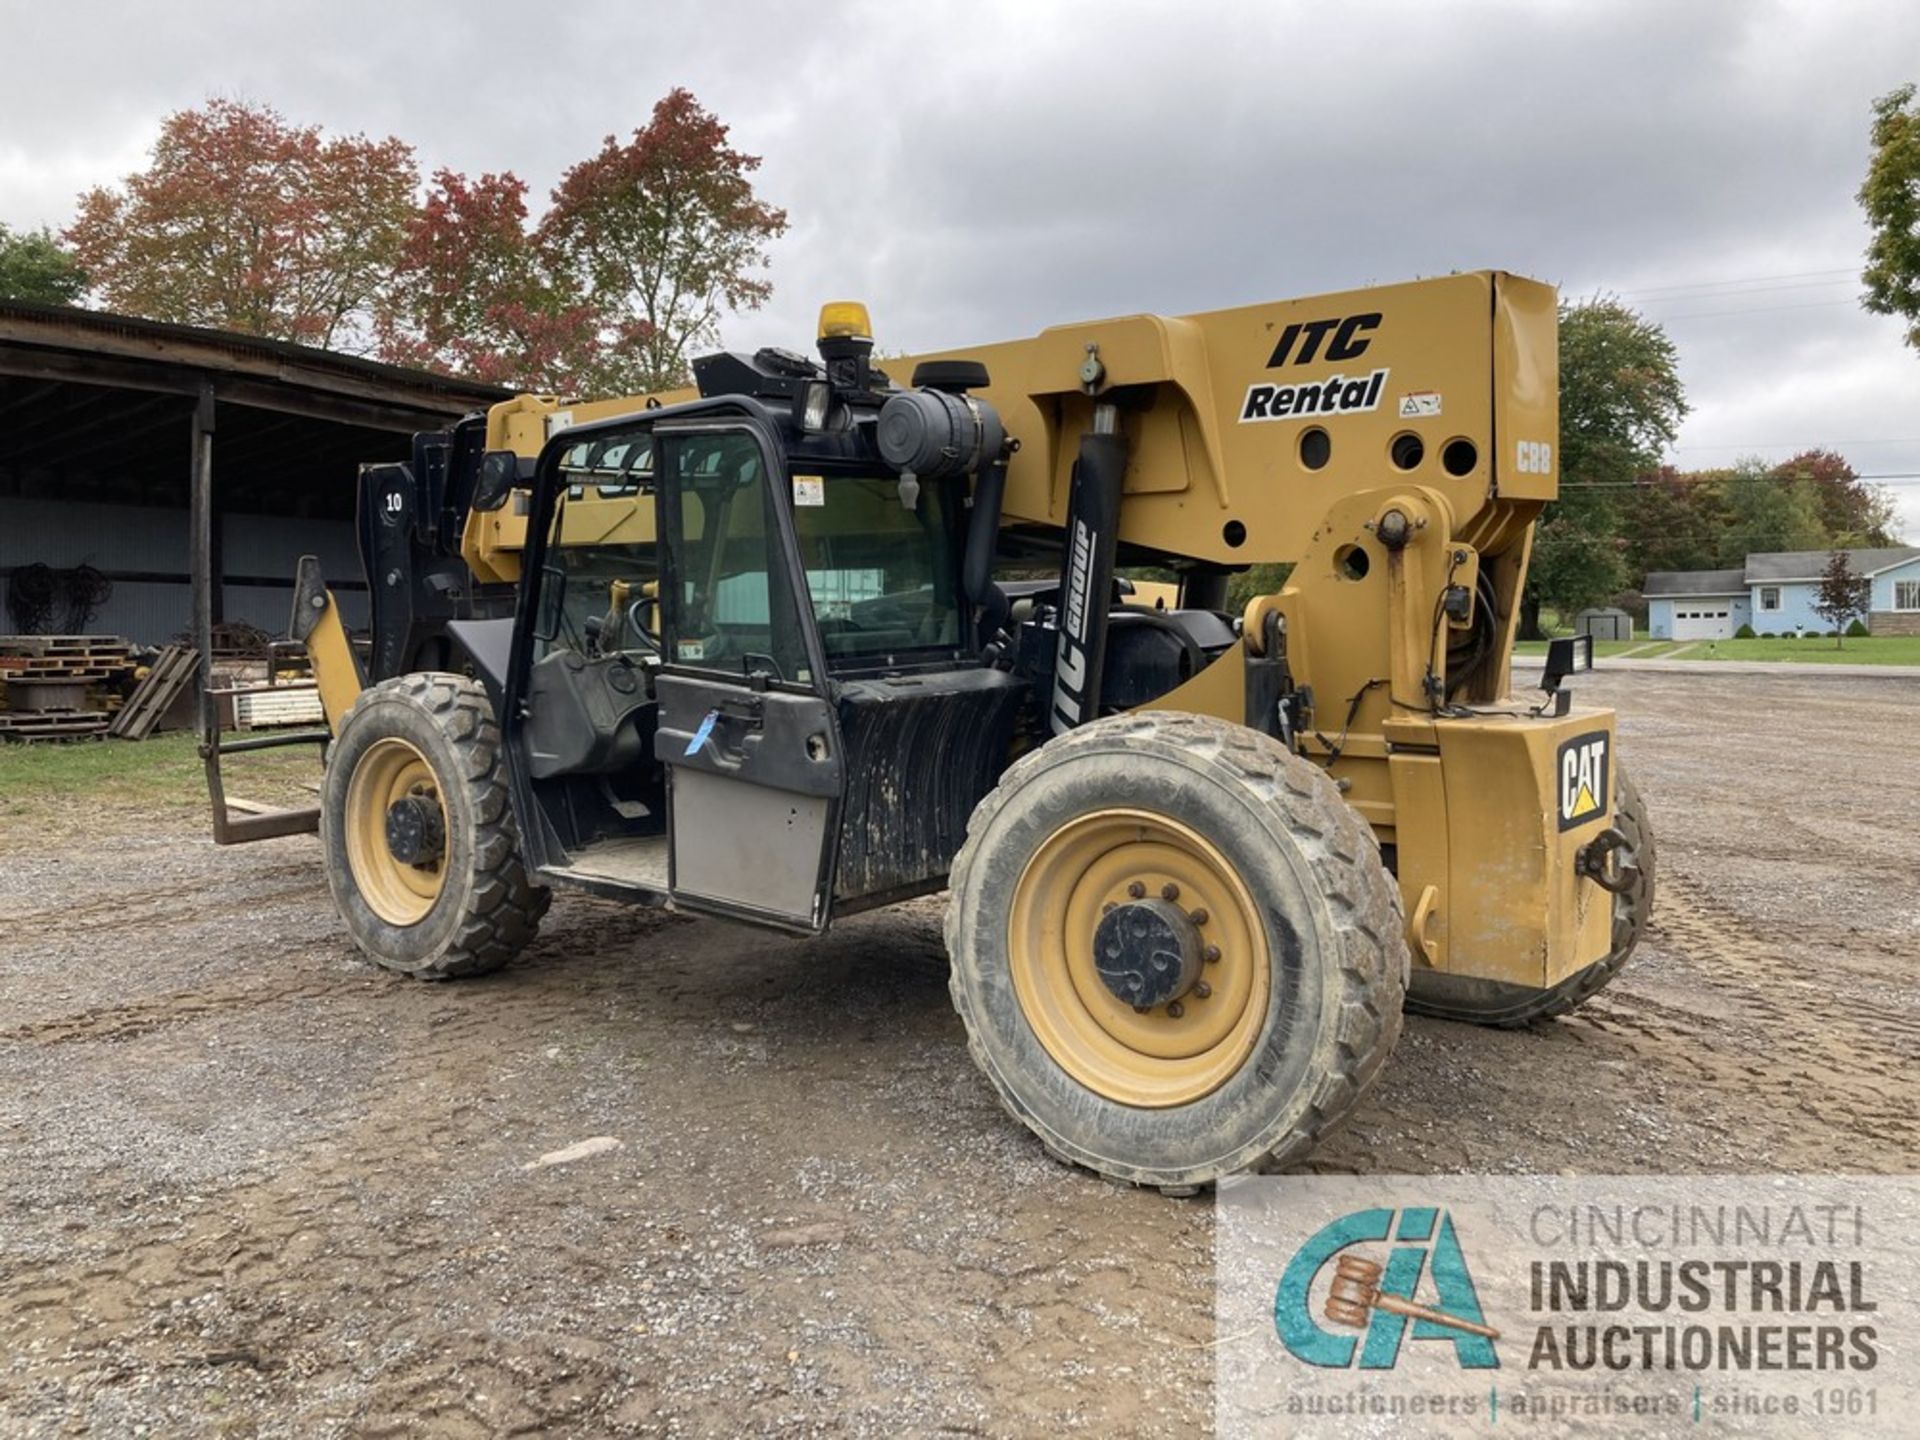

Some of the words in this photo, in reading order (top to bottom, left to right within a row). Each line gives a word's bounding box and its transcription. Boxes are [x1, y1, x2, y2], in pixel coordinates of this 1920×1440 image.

[1265, 312, 1383, 369] ITC
[1242, 372, 1386, 420] Rental
[386, 493, 402, 511] 10
[1066, 519, 1090, 639] GROUP
[1561, 740, 1604, 820] CAT
